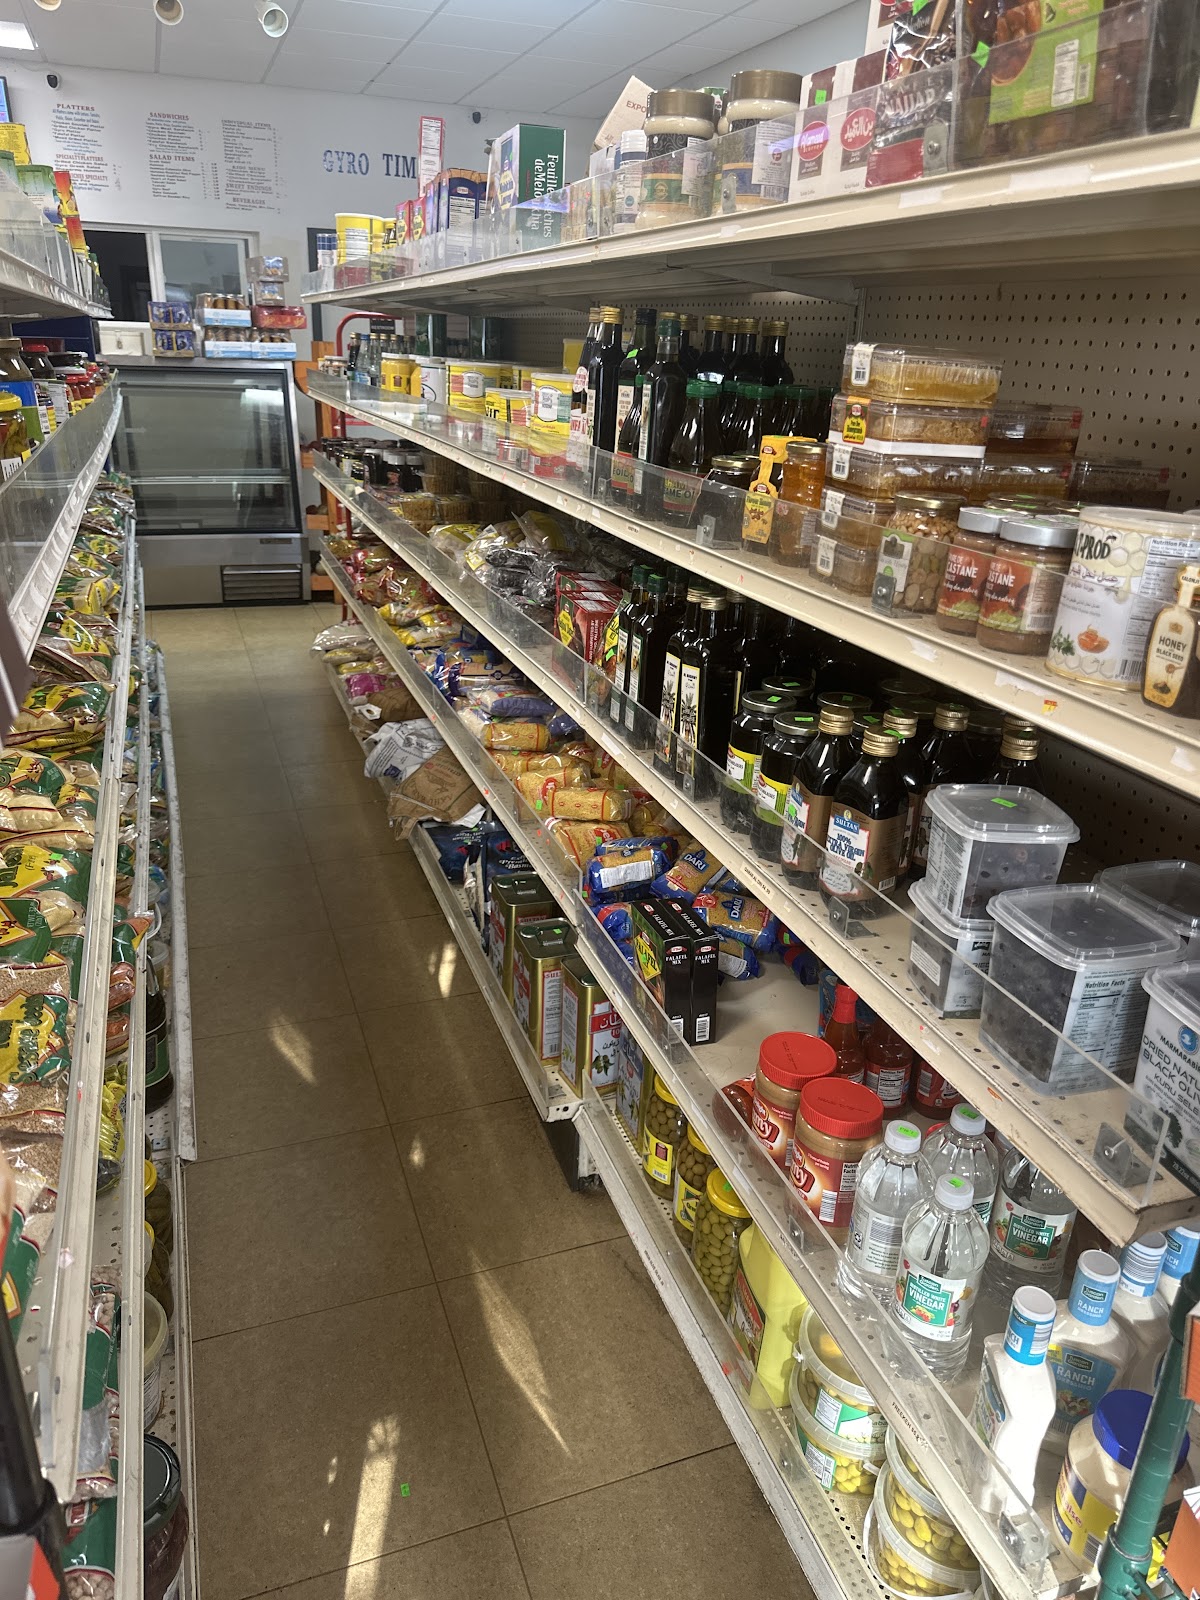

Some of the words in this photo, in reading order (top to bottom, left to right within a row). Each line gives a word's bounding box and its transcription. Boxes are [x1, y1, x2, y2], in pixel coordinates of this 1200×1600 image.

[56, 103, 95, 111] PLATTERS
[626, 100, 647, 113] EXPO
[149, 112, 190, 121] SANDWICHES
[323, 150, 369, 175] GYRO
[382, 153, 417, 179] TIM
[1151, 538, 1178, 547] Nutrition
[946, 562, 979, 578] CASTANE
[1159, 635, 1187, 651] HONEY
[1156, 647, 1172, 659] BLACK
[1172, 651, 1184, 662] SEED
[835, 816, 858, 833] SULTAN
[837, 833, 852, 845] 100%
[843, 842, 865, 857] VIRGIN
[683, 853, 706, 871] DARI
[731, 899, 742, 919] DARI
[680, 912, 697, 930] FALAFEL
[666, 954, 687, 962] FALAFEL
[695, 953, 716, 961] FALAFEL
[1084, 980, 1110, 989] Nutrition
[1112, 978, 1126, 987] Facts
[1142, 1034, 1171, 1065] DRIED
[1143, 1048, 1177, 1085] BLACK
[1153, 1072, 1177, 1098] KURU
[1012, 1227, 1049, 1245] VINEGAR
[1013, 1222, 1035, 1235] DISTILLED
[1035, 1230, 1050, 1238] WHITE
[909, 1286, 945, 1311] VINEGAR
[1084, 1286, 1104, 1297] Tuscan
[1077, 1299, 1104, 1314] RANCH
[1069, 1355, 1089, 1366] Tuscan
[1056, 1375, 1093, 1391] DRESSING
[1057, 1365, 1095, 1386] RANCH
